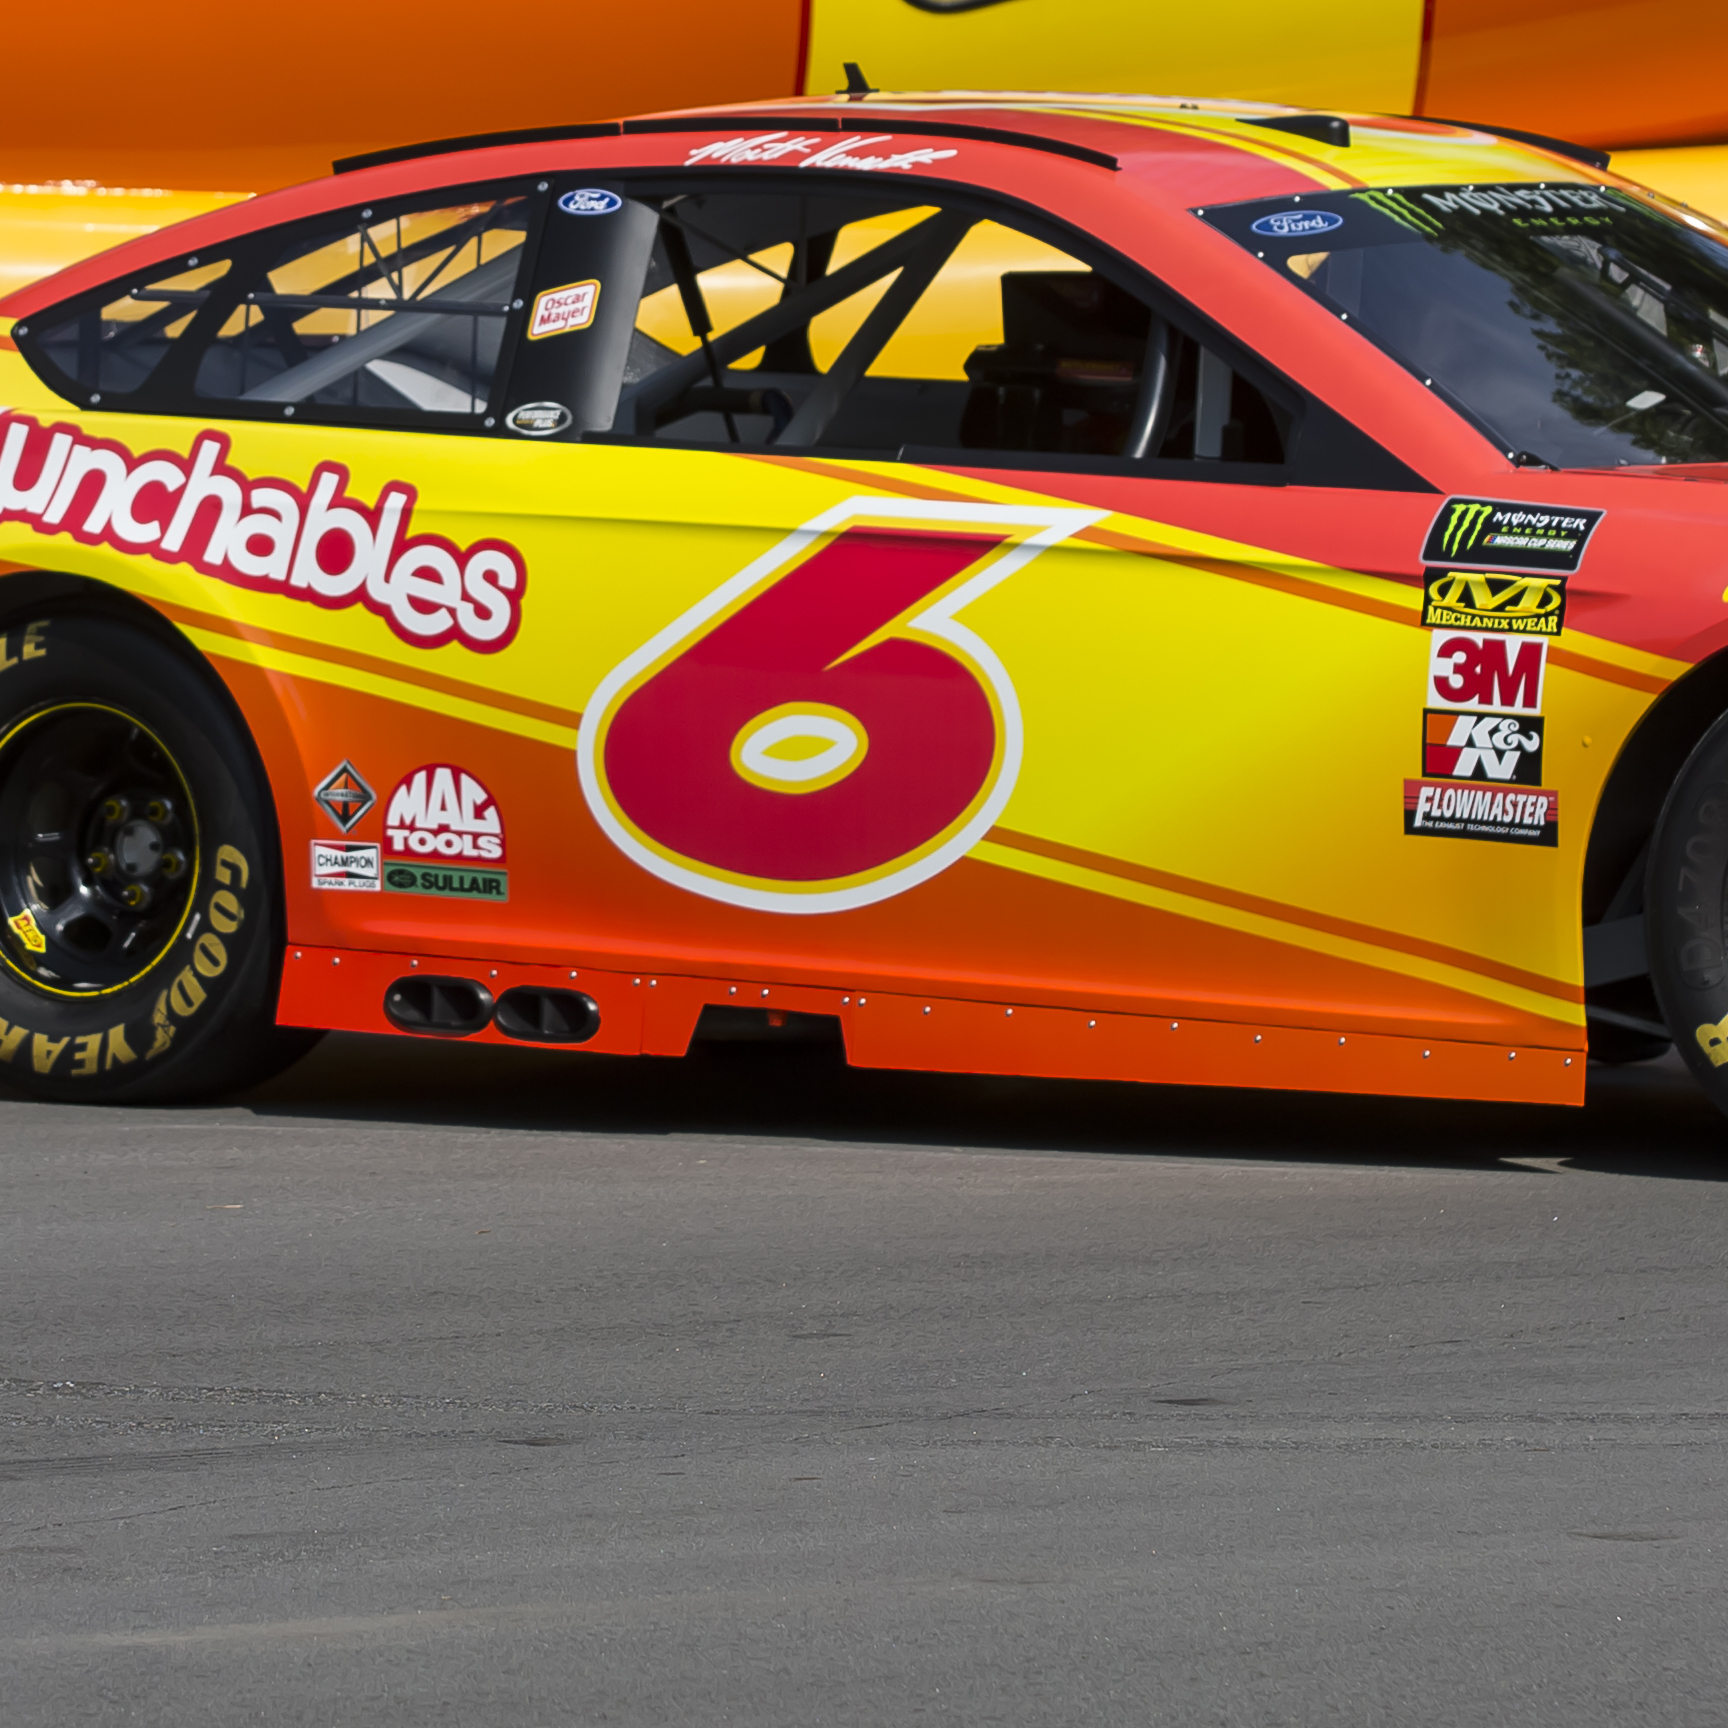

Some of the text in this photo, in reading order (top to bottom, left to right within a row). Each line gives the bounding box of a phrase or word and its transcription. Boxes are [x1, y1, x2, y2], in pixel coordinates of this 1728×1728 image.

[567, 191, 612, 211] Ford
[1268, 212, 1330, 234] Ford
[1512, 215, 1615, 229] ENERGY
[543, 290, 590, 313] Oscar
[537, 304, 590, 328] Mayer
[1500, 525, 1569, 537] ENERGY
[1425, 605, 1559, 633] MECHANIX WEAR
[1433, 636, 1545, 709] 3M
[578, 496, 1110, 913] 6
[385, 767, 502, 835] MAC
[1412, 785, 1550, 828] FLOWMASTER
[1466, 823, 1510, 834] TECHNOLOGY
[1509, 826, 1542, 837] COMPANY
[385, 828, 504, 860] TOOLS
[316, 853, 375, 869] CHAMPION
[316, 878, 377, 889] SPARK PLUGS
[420, 873, 503, 896] SULLAIR
